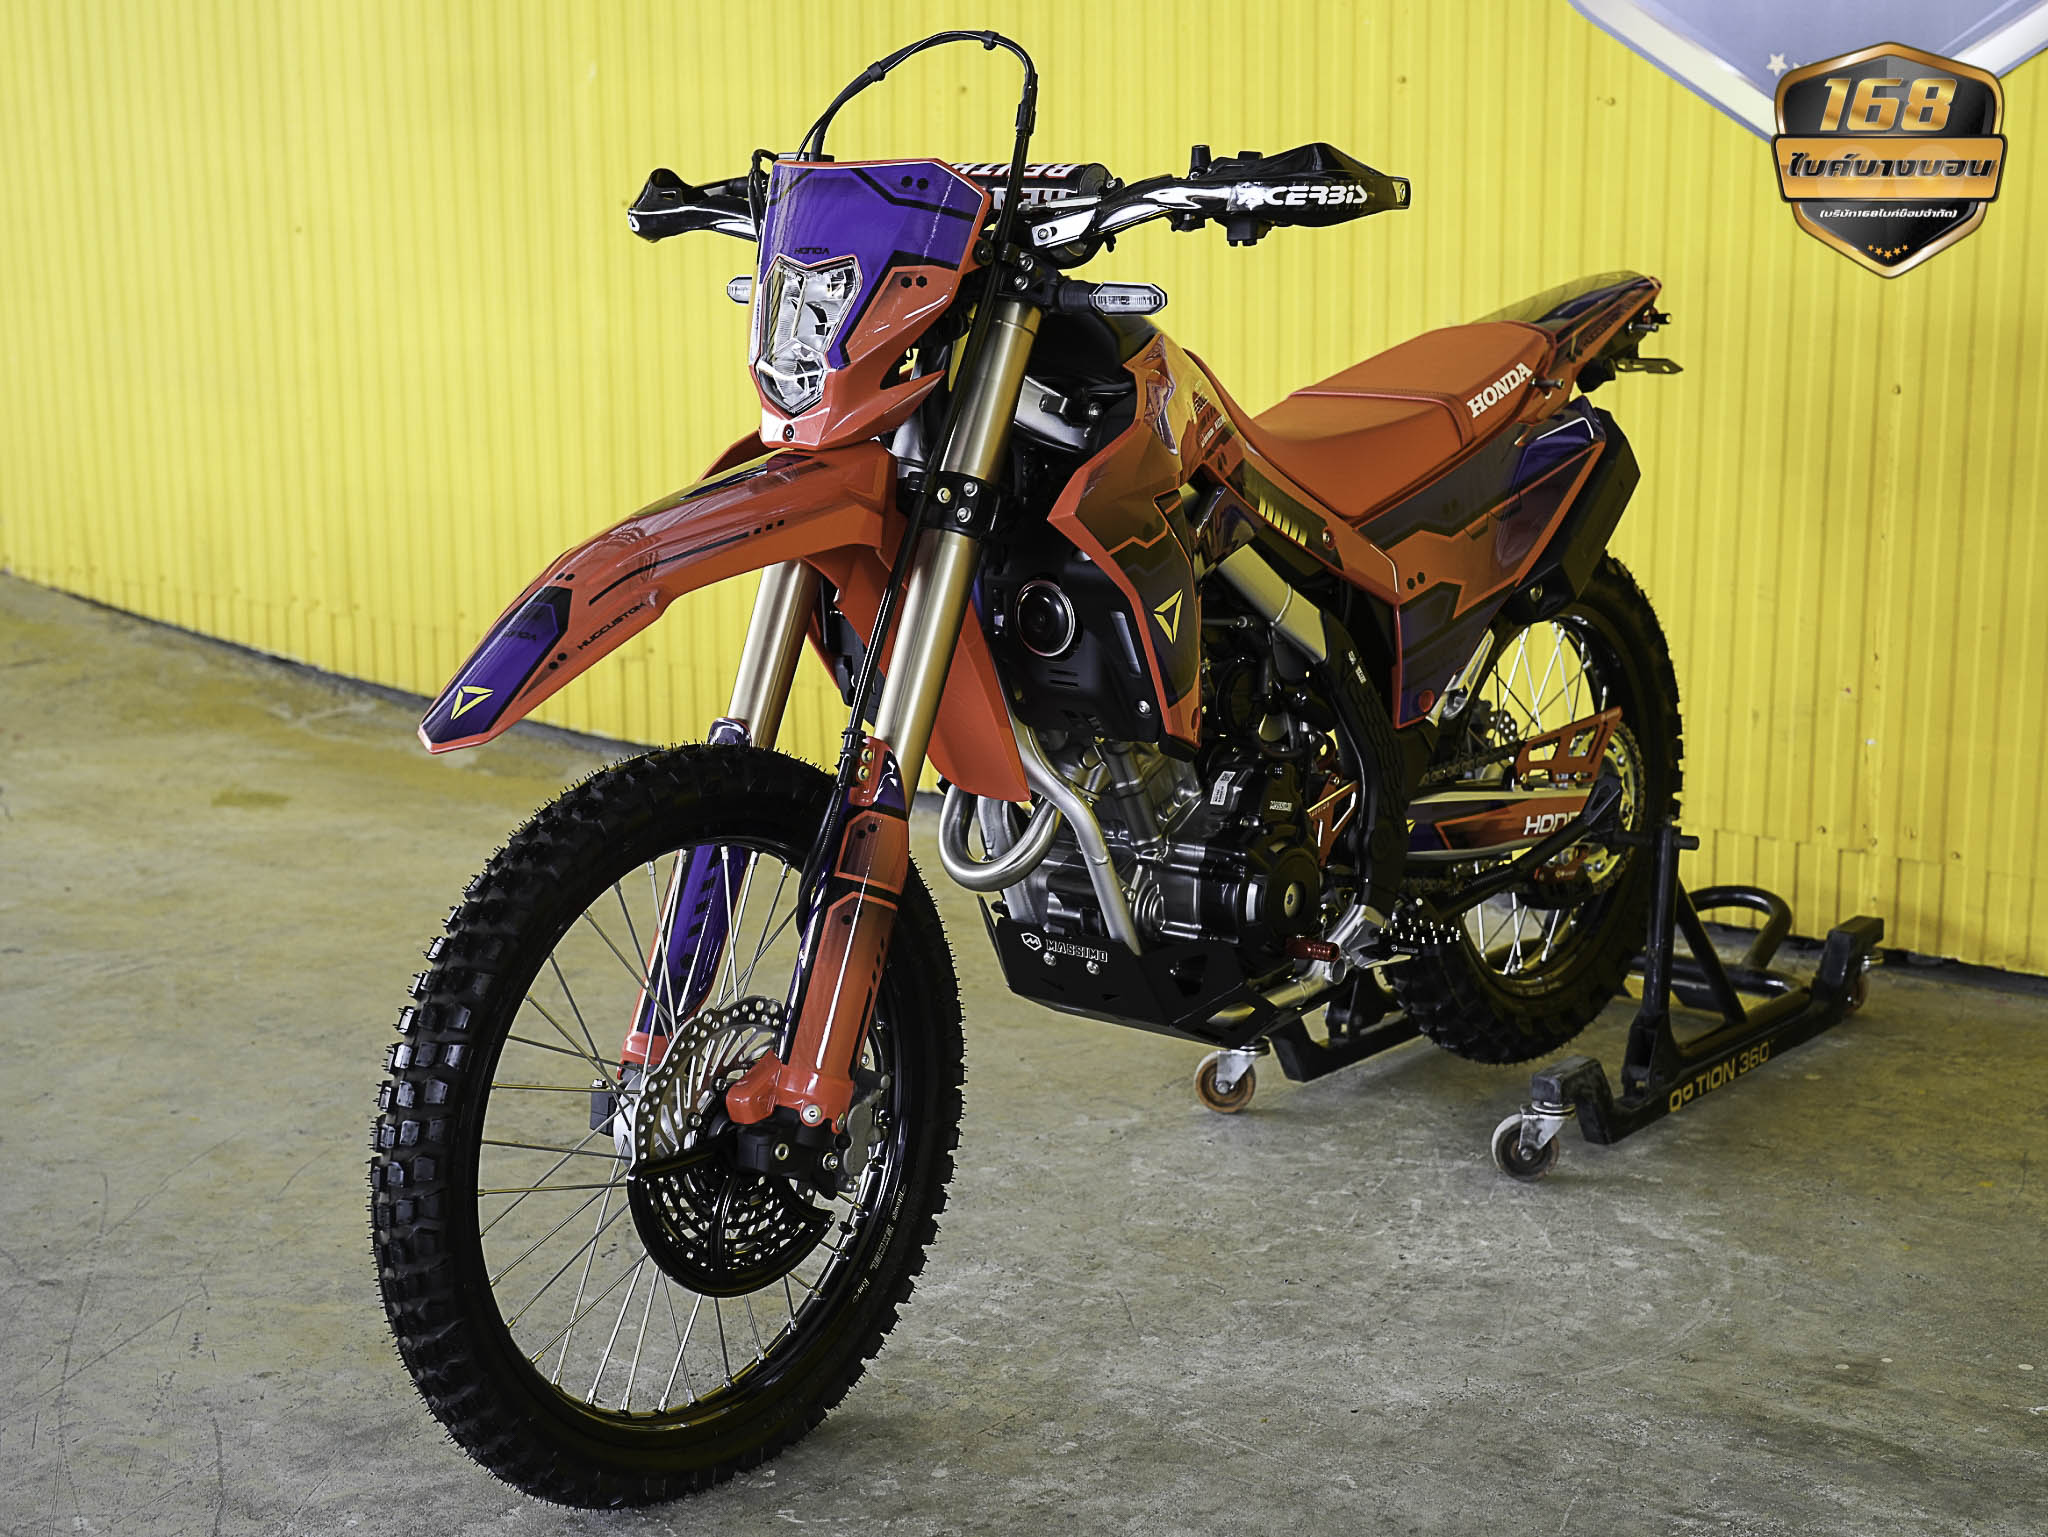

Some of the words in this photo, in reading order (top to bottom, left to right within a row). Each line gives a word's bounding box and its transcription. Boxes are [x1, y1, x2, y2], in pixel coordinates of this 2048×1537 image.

[1466, 361, 1533, 418] HONDA
[1046, 938, 1108, 963] MASSIMO
[1669, 1056, 1735, 1113] OPTION
[1739, 1041, 1770, 1073] 360
